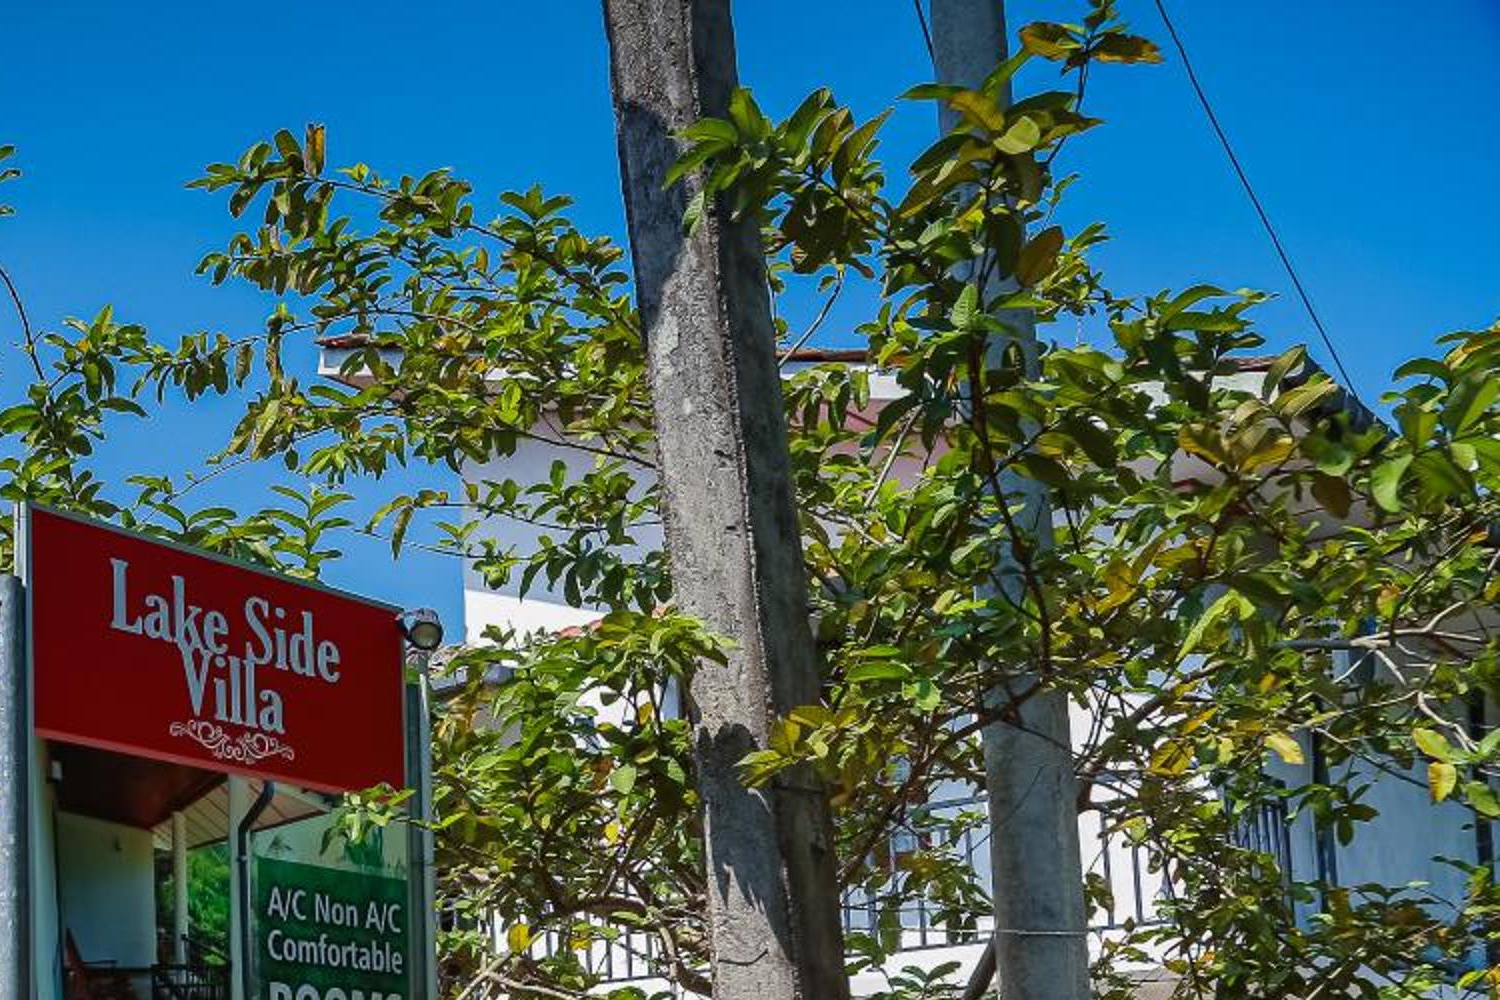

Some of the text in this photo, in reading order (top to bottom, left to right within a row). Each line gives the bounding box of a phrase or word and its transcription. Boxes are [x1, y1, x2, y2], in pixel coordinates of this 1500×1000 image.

[110, 557, 341, 683] Lake Side
[178, 641, 285, 734] Villa
[267, 885, 402, 934] A/C Non A/C
[267, 929, 403, 975] Comfortable
